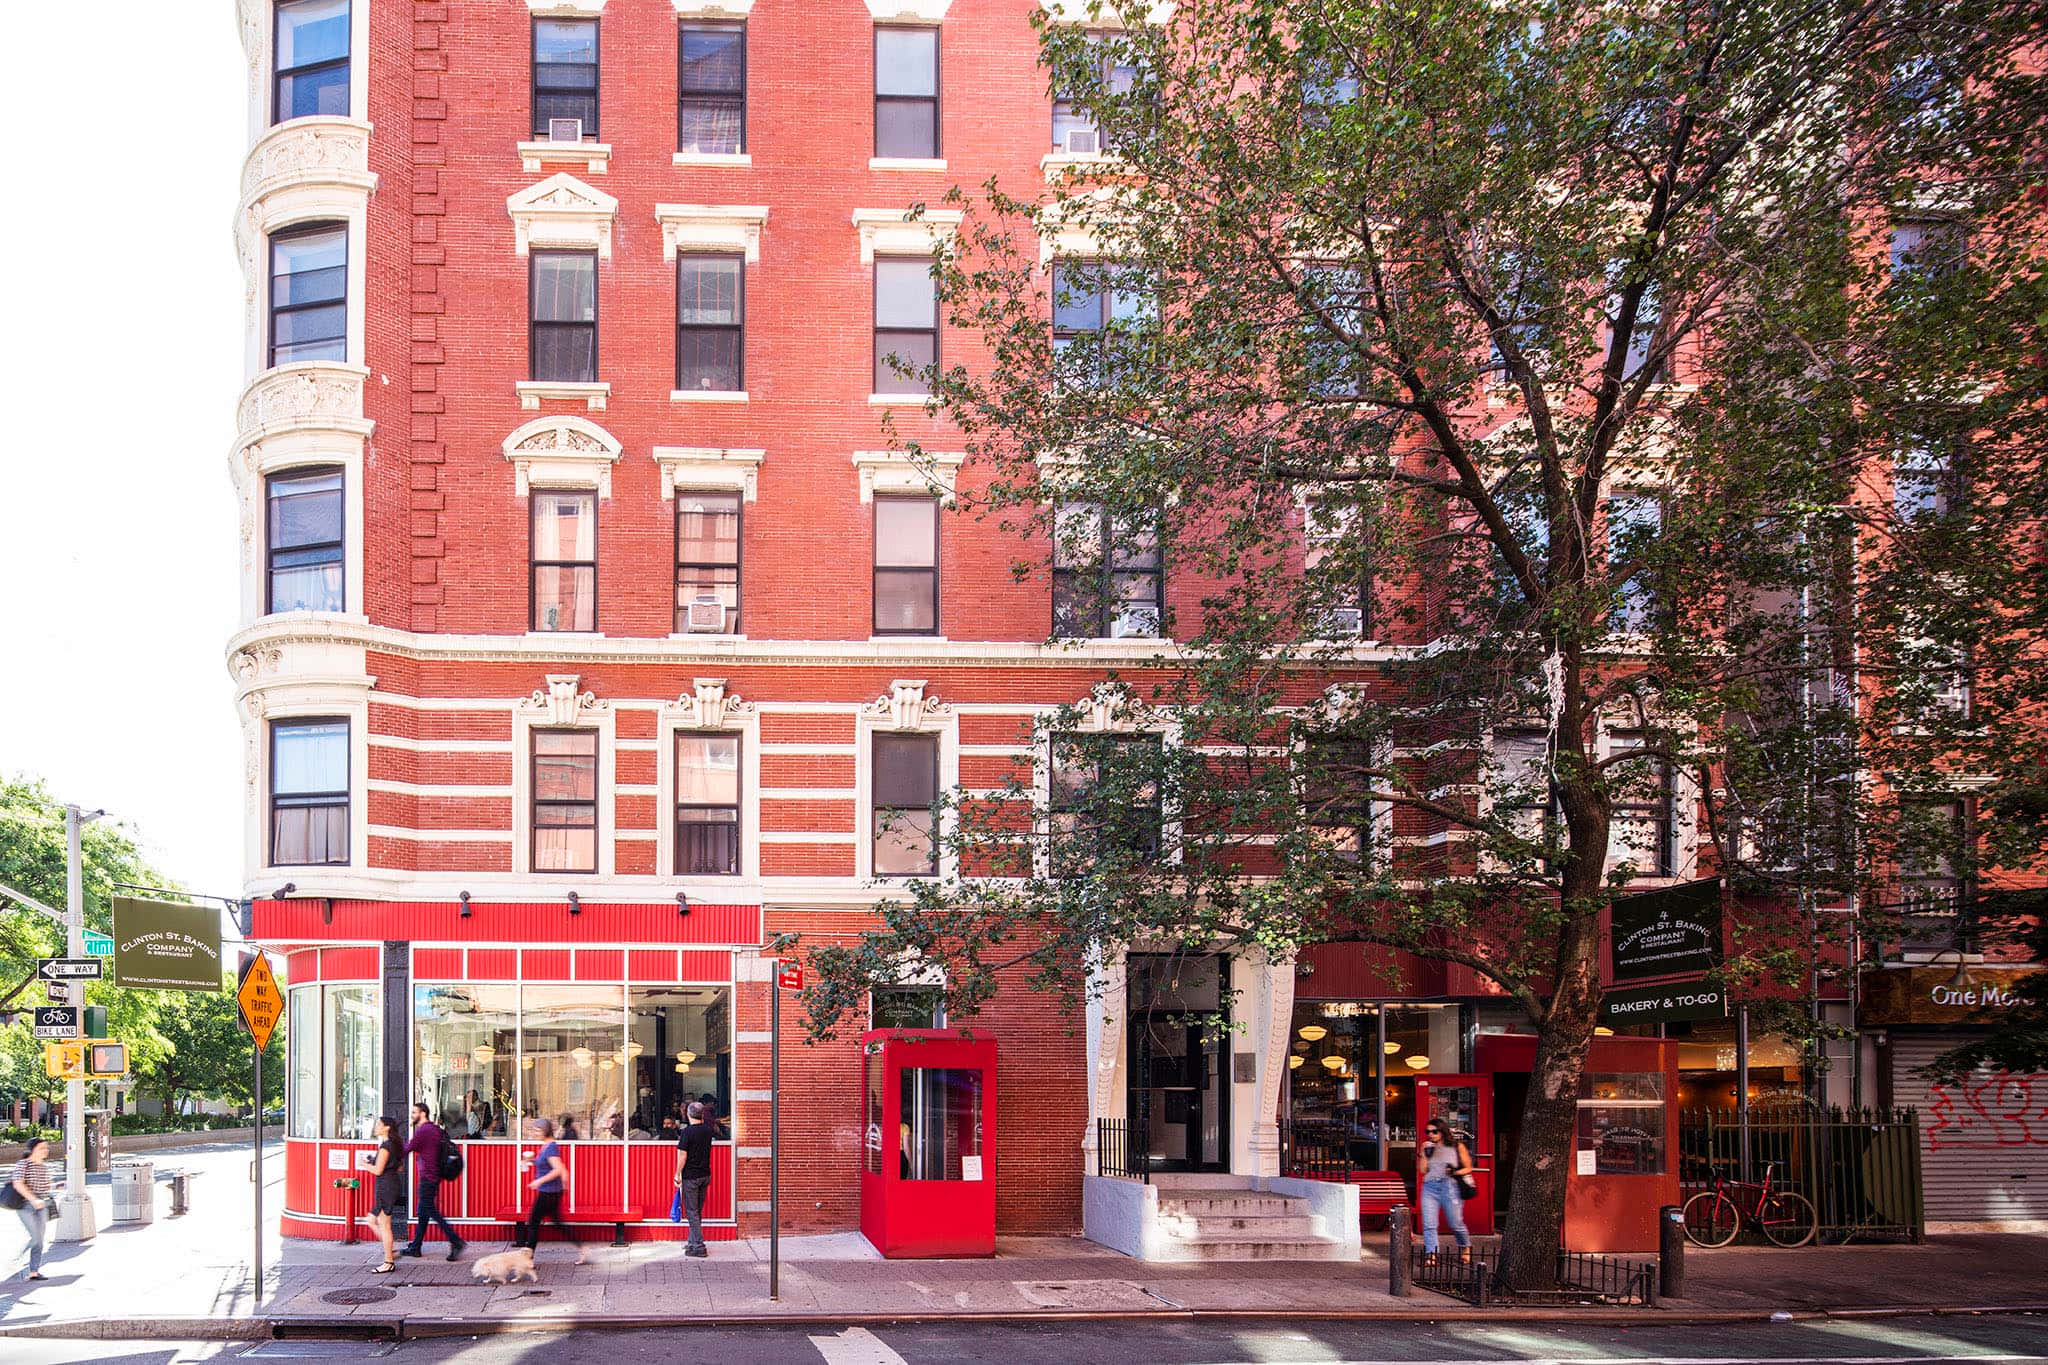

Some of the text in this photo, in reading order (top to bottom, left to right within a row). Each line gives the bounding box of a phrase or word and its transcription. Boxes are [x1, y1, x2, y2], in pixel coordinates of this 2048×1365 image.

[1618, 920, 1712, 951] CLINTON ST. BAKING
[1640, 930, 1686, 944] COMPANY
[121, 932, 163, 952] CLINTON
[166, 932, 181, 941] ST.
[183, 934, 218, 959] BAKING
[146, 943, 194, 953] COMPANY
[47, 964, 94, 974] ONE WAY
[256, 969, 268, 982] TWO
[52, 986, 65, 996] ONE
[256, 985, 267, 996] WAY
[1931, 985, 2036, 1007] One Mo
[251, 999, 273, 1014] TRAFFIC
[1611, 993, 1719, 1014] BAKERY & TO-GO
[253, 1016, 271, 1029] AHEAD
[36, 1027, 76, 1036] BIKE LANE
